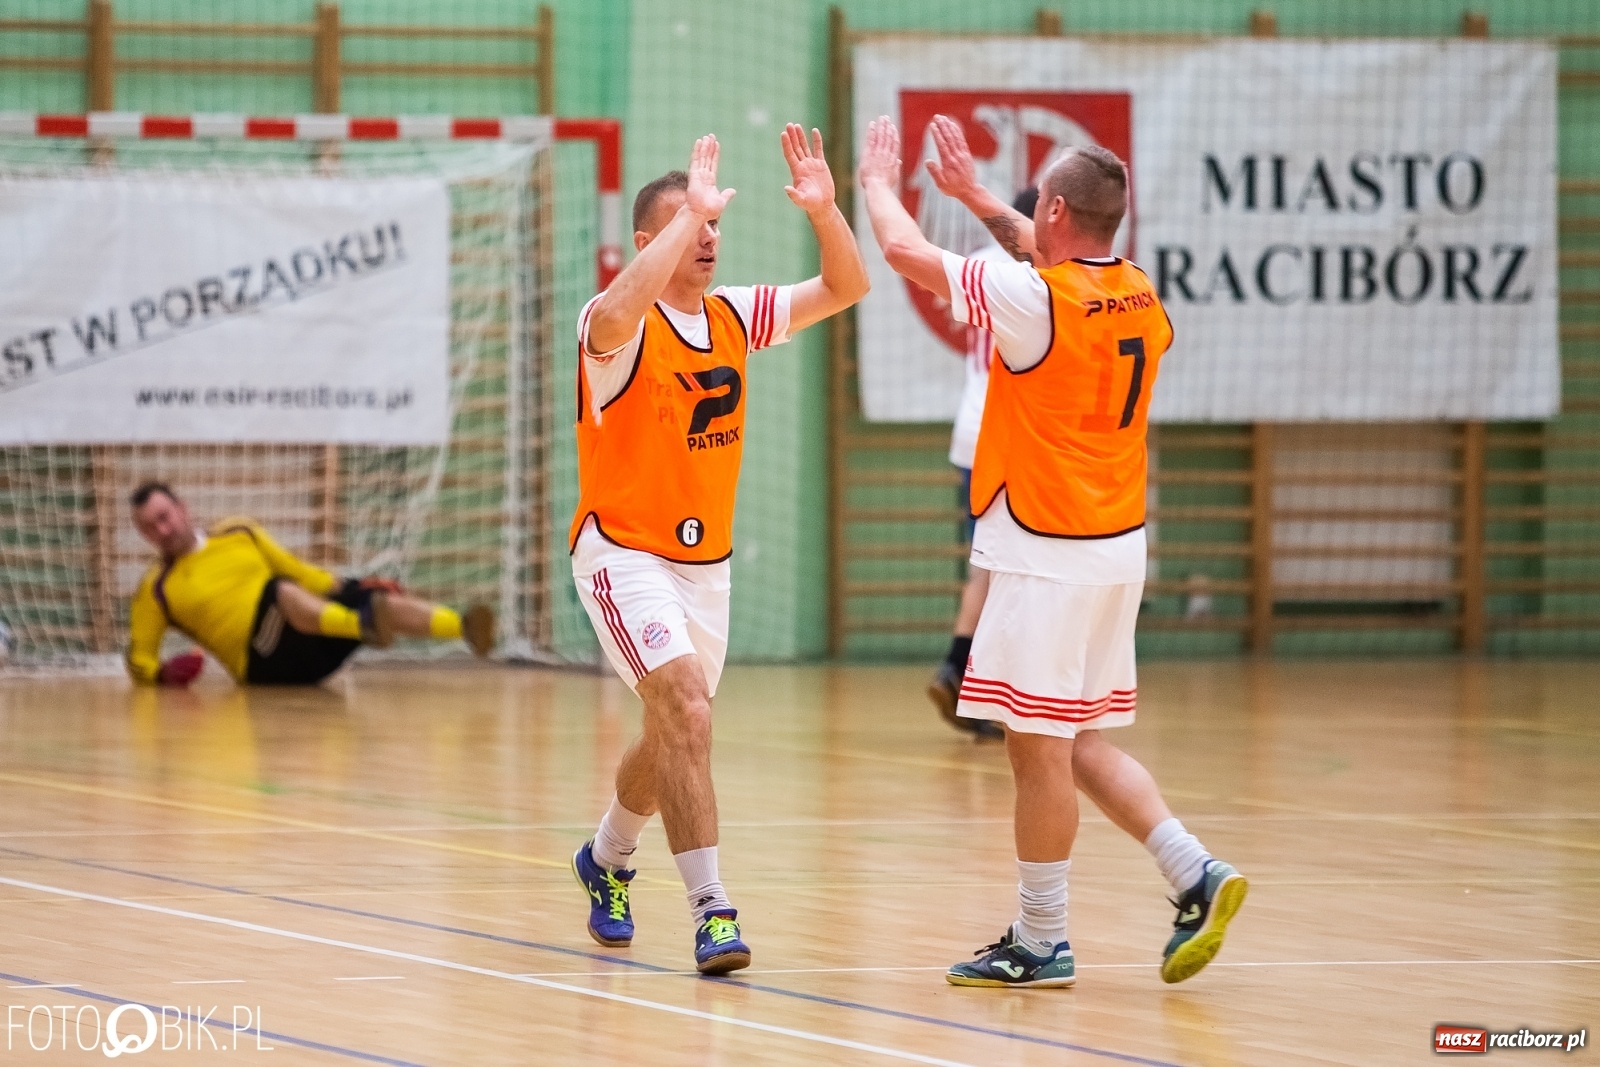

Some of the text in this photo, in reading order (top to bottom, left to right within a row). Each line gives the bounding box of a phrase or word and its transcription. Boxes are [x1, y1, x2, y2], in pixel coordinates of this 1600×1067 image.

[1201, 151, 1487, 214] MIASTO
[69, 313, 118, 357] W
[129, 220, 407, 340] PORZĄDKU!
[1153, 225, 1533, 306] RACIBÓRZ
[1106, 290, 1157, 315] PATRICK
[1117, 336, 1147, 430] 7
[686, 426, 740, 453] PATRICK
[682, 518, 699, 546] 6
